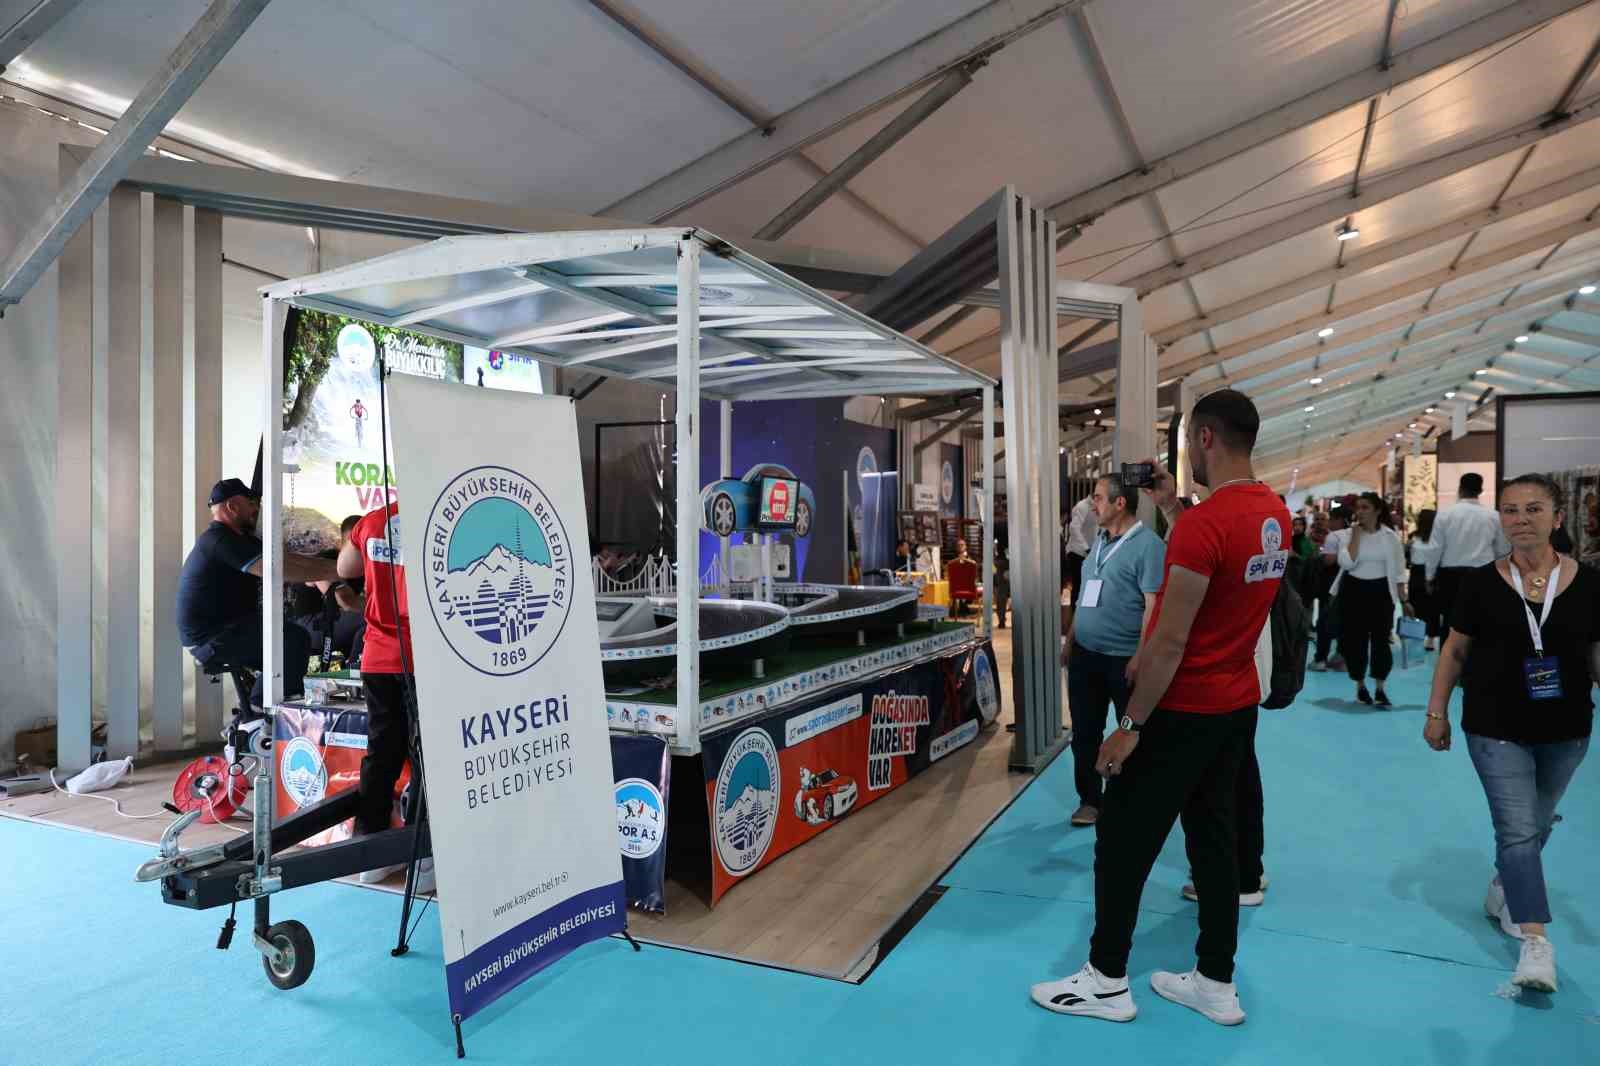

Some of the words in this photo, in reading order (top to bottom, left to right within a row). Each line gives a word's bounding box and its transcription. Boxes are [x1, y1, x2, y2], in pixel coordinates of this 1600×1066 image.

[442, 476, 533, 522] BÜYÜKŞEHİR
[432, 523, 456, 620] KAYSERİ
[533, 502, 566, 609] BELEDİYESİ
[491, 647, 528, 667] 1869
[461, 694, 570, 749] KAYSERİ
[872, 691, 929, 725] DOĞASINDA
[464, 732, 571, 781] BÜYÜKŞEHİR
[869, 725, 916, 755] HAREKET
[466, 757, 574, 810] BELEDİYESİ
[868, 758, 891, 787] VAR
[740, 848, 757, 865] 1869
[464, 956, 503, 993] KAYSERİ
[503, 926, 559, 969] BÜYÜKŞEHİR
[560, 900, 616, 936] BELEDİYESİ
